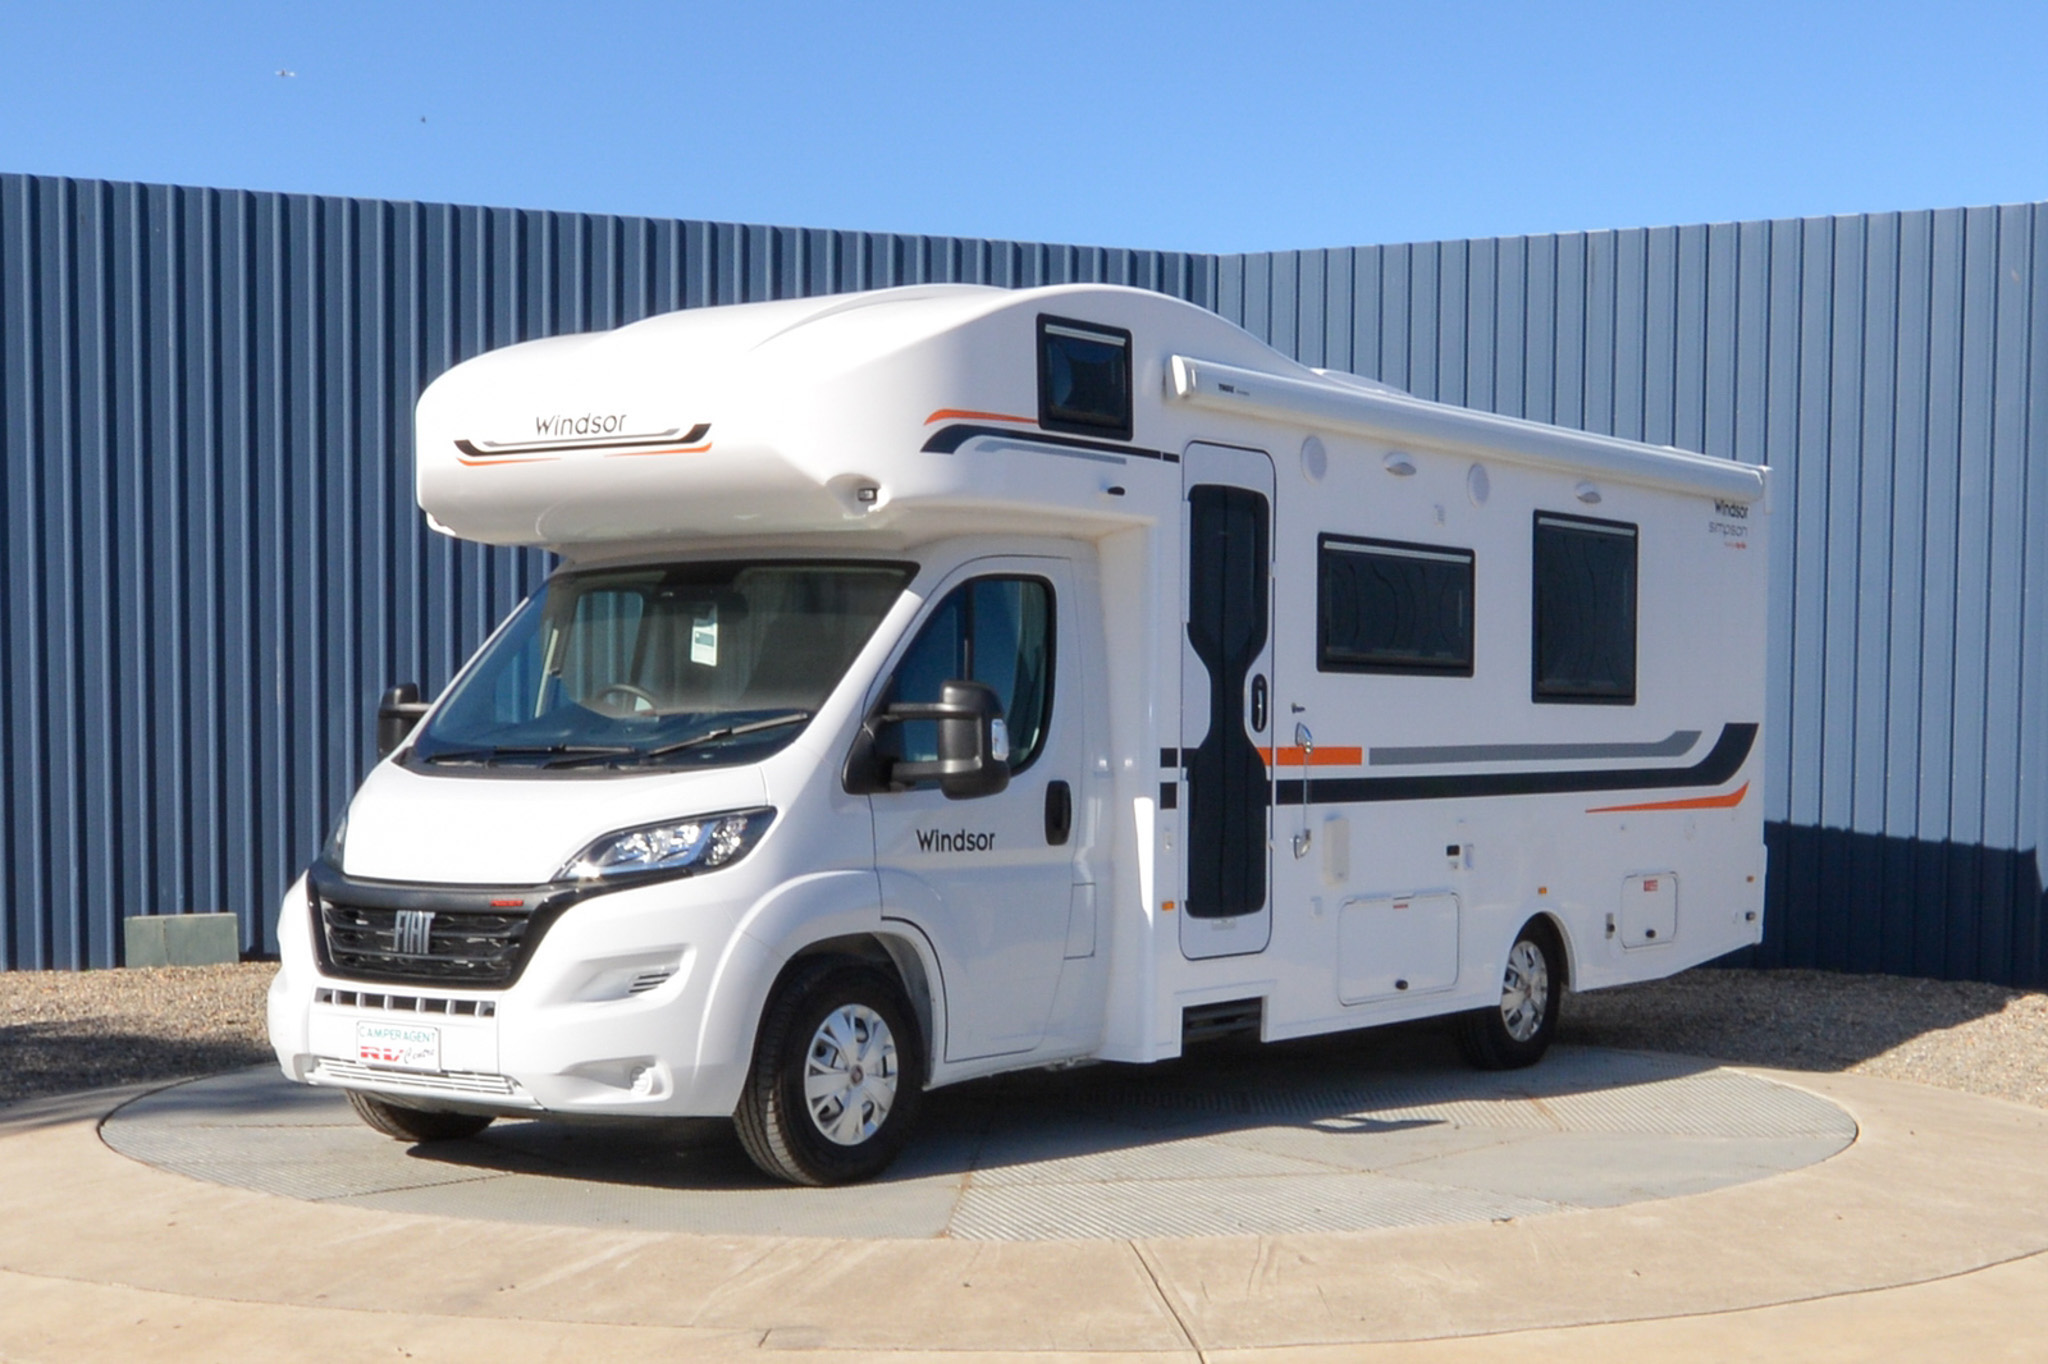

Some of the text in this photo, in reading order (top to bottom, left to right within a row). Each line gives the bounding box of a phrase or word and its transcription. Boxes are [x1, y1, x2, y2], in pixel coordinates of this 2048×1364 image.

[536, 413, 627, 436] Windsor
[915, 828, 996, 852] Windsor
[392, 910, 436, 954] FIAT
[360, 1046, 403, 1062] RV
